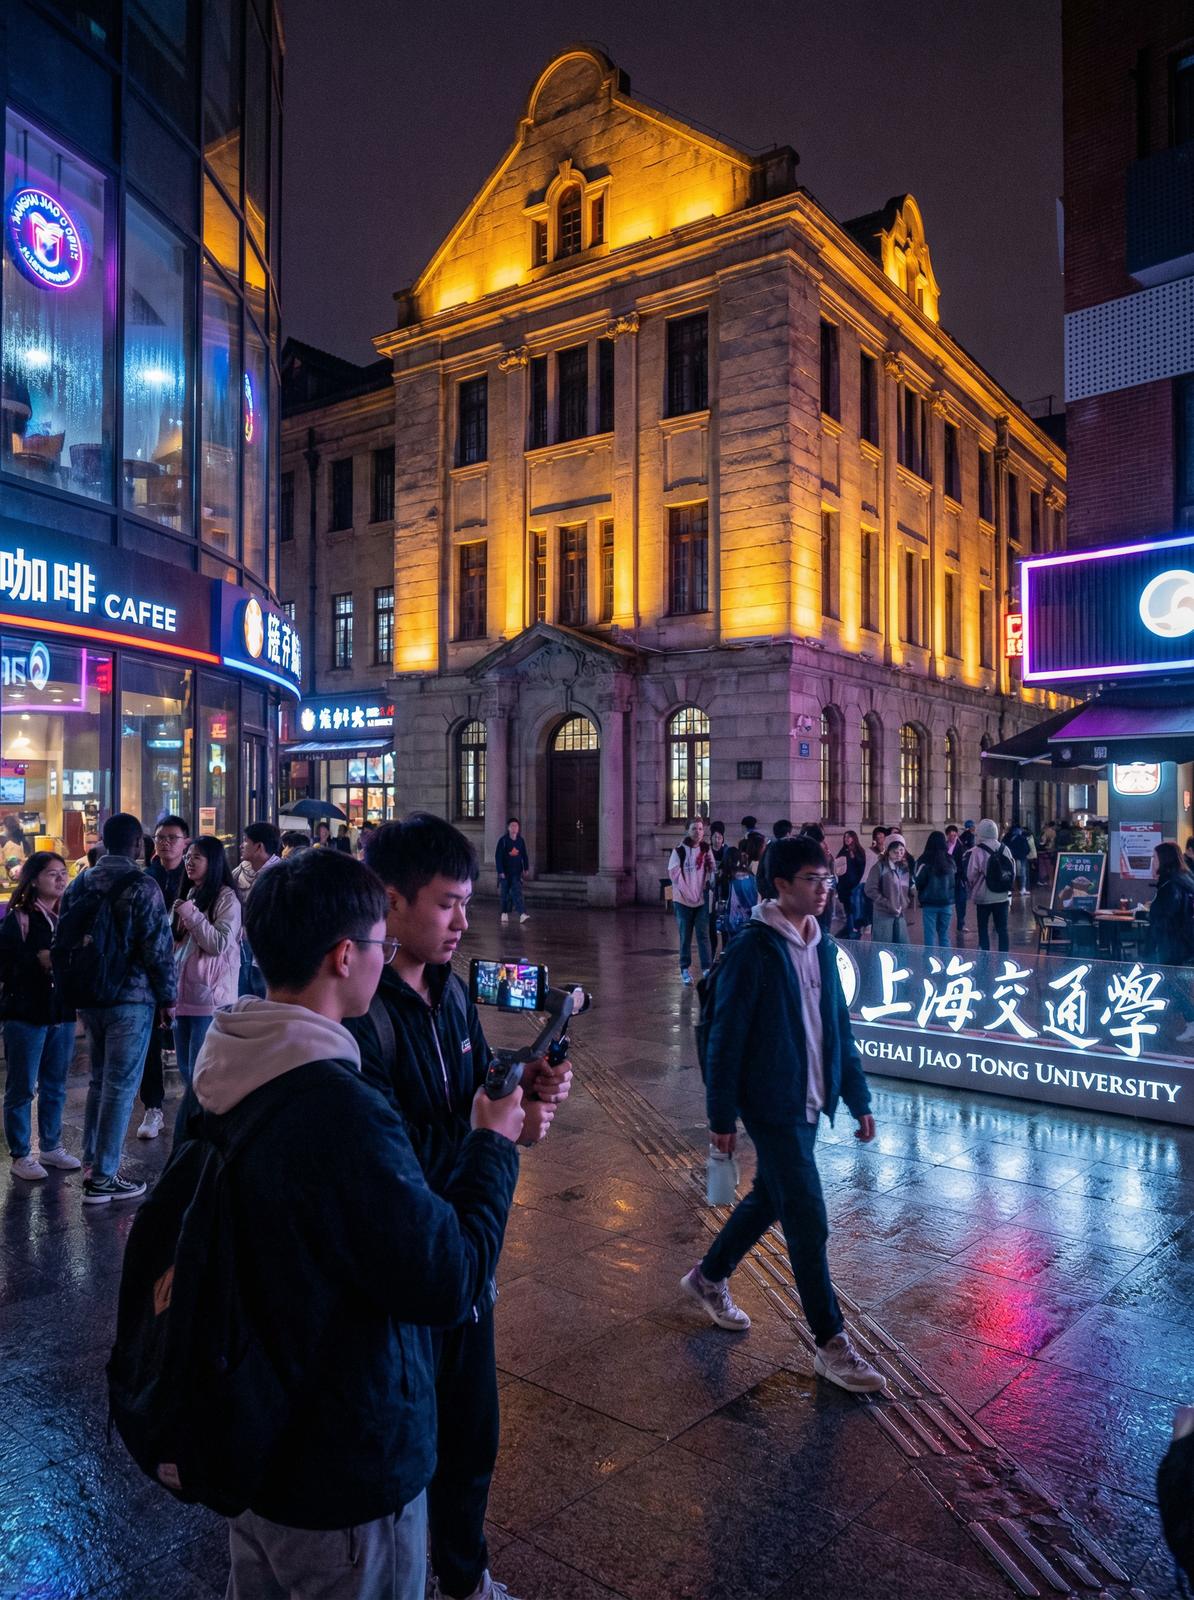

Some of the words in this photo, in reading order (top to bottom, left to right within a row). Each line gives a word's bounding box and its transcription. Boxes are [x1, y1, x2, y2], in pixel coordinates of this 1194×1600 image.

[0, 548, 96, 613] 咖啡
[104, 594, 177, 633] CAFEE
[918, 1045, 961, 1069] JIAO
[966, 1052, 1030, 1081] TONG
[1034, 1062, 1182, 1104] UNIVERSITY
